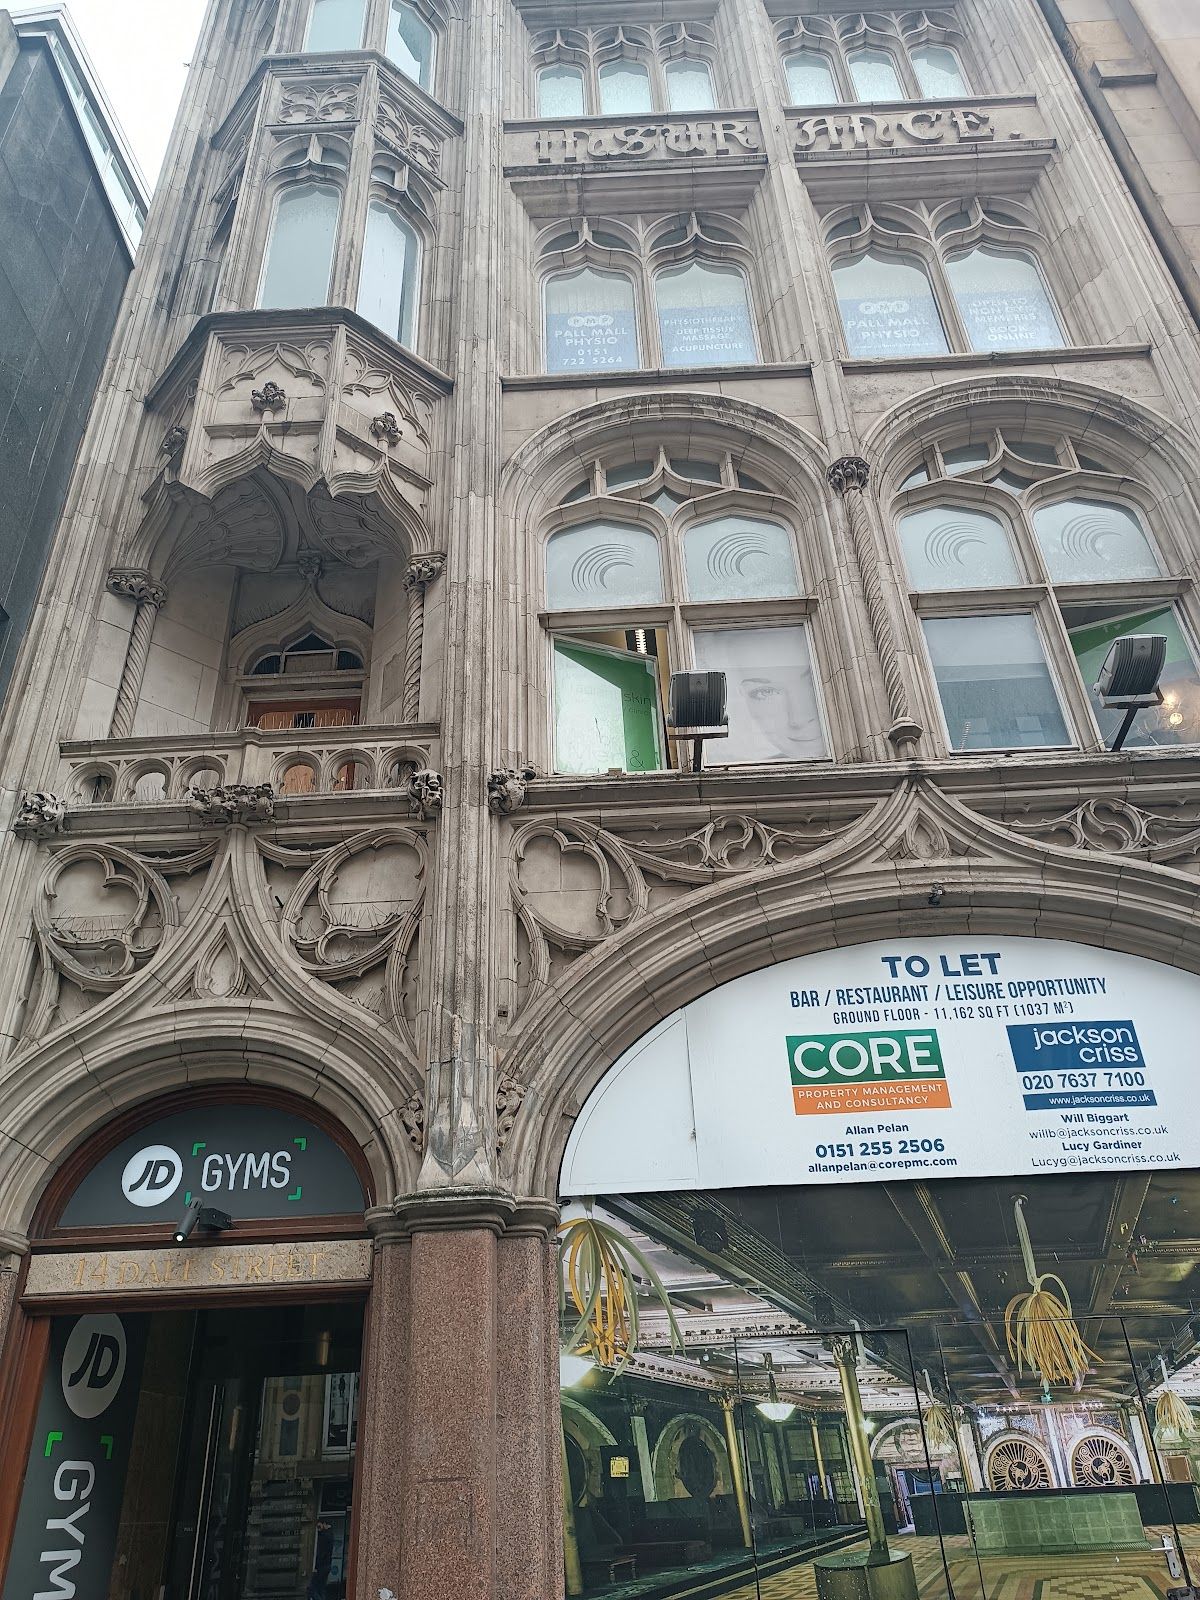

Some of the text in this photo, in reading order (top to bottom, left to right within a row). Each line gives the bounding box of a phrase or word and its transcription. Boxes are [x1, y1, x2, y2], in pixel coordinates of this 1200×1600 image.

[848, 316, 929, 329] PALL MALL
[554, 326, 629, 339] PALL MALL
[861, 328, 920, 340] PHYSIO
[565, 336, 618, 347] PHYSIO
[672, 341, 744, 353] ACUPUNCTURE
[562, 355, 624, 366] 722 5264
[577, 348, 609, 357] 0151
[881, 952, 1002, 979] TO LET
[789, 977, 1107, 1008] BAR / RESTAURANT / LEISURE OPPORTUNITY
[833, 1009, 880, 1024] GROUND
[884, 1007, 921, 1022] FLOOR
[933, 1006, 975, 1021] 11,162
[978, 1005, 994, 1019] SQ
[997, 1004, 1010, 1018] FT
[1033, 1025, 1134, 1051] jackson
[793, 1034, 941, 1079] CORE
[1079, 1042, 1139, 1065] criss
[1022, 1071, 1145, 1091] 020 7637 7100
[798, 1083, 943, 1099] PROPERTY MANAGEMENT
[816, 1096, 929, 1110] AND CONSULTANCY
[1048, 1093, 1151, 1106] www.jacksoncriss.co.uk
[1060, 1112, 1130, 1125] Will Biggart
[845, 1122, 910, 1136] Allan Pelan
[1029, 1124, 1169, 1140] willb@jacksoncriss.co.uk
[815, 1138, 946, 1159] 0151 255 2506
[1061, 1139, 1143, 1152] Lucy Gardiner
[808, 1156, 958, 1174] allanpelan@corepmc.com
[1031, 1151, 1182, 1168] Lucyg@jacksoncriss.co.uk
[129, 1150, 293, 1193] JD GYMS
[73, 1254, 109, 1286] 14
[208, 1250, 327, 1282] STREET
[68, 1332, 121, 1390] JD
